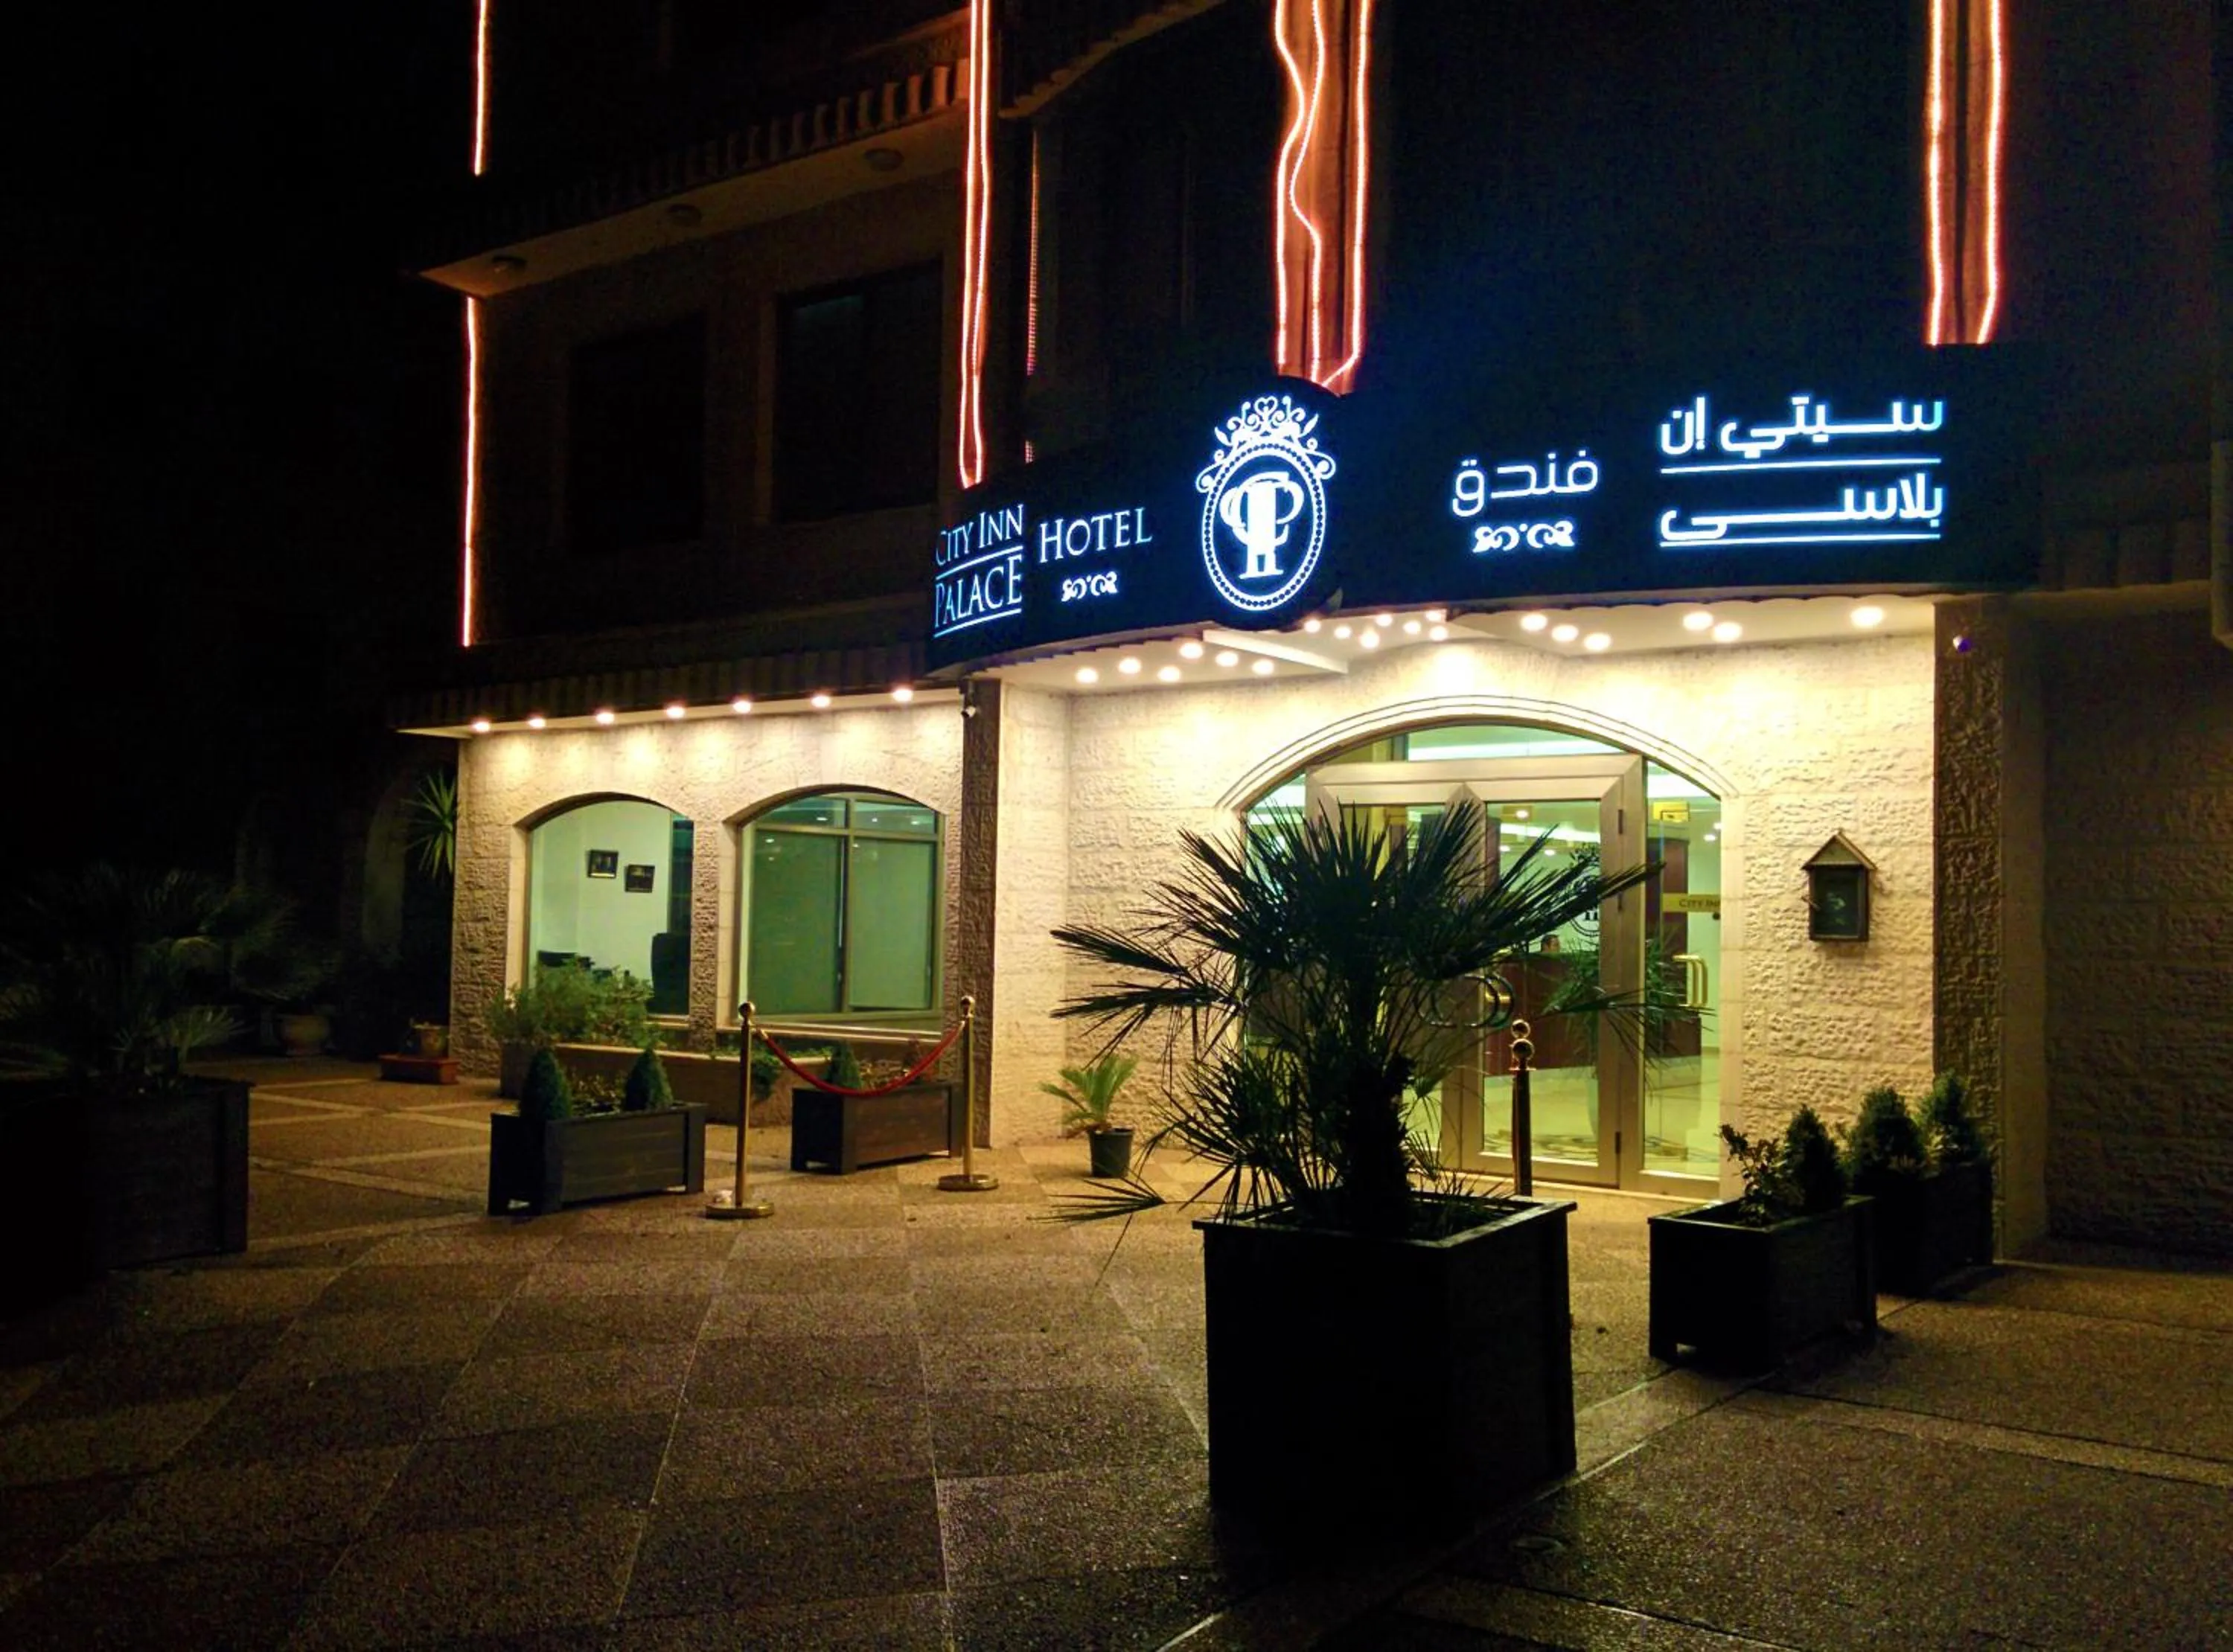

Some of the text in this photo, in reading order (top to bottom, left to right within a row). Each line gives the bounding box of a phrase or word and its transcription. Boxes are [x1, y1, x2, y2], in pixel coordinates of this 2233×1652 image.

[1720, 395, 1943, 459] سيتي
[1452, 449, 1599, 517] فندق
[936, 503, 1023, 566] CITY INN
[1039, 507, 1153, 563] HOTEL
[934, 554, 1023, 628] PALACE
